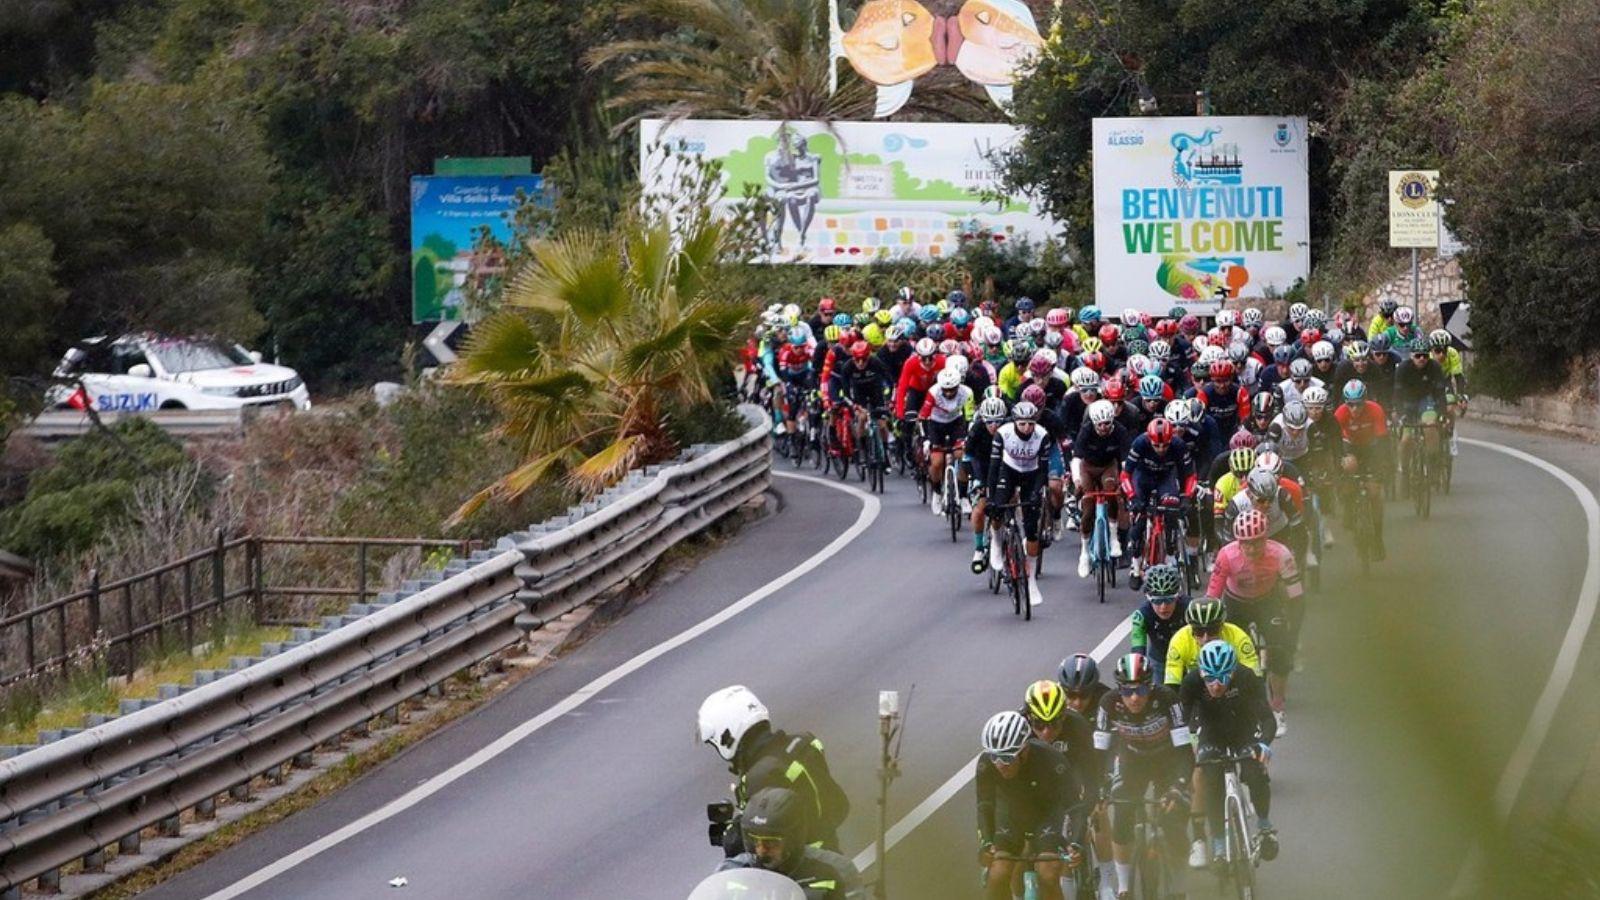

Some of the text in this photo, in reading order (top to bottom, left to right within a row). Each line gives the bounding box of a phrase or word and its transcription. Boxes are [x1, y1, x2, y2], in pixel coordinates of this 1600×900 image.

[1107, 135, 1145, 146] ALASSIO
[439, 193, 462, 203] Villa
[1122, 186, 1283, 220] BENVENUTI
[1122, 220, 1283, 254] WELCOME
[97, 392, 158, 410] SUZUKI
